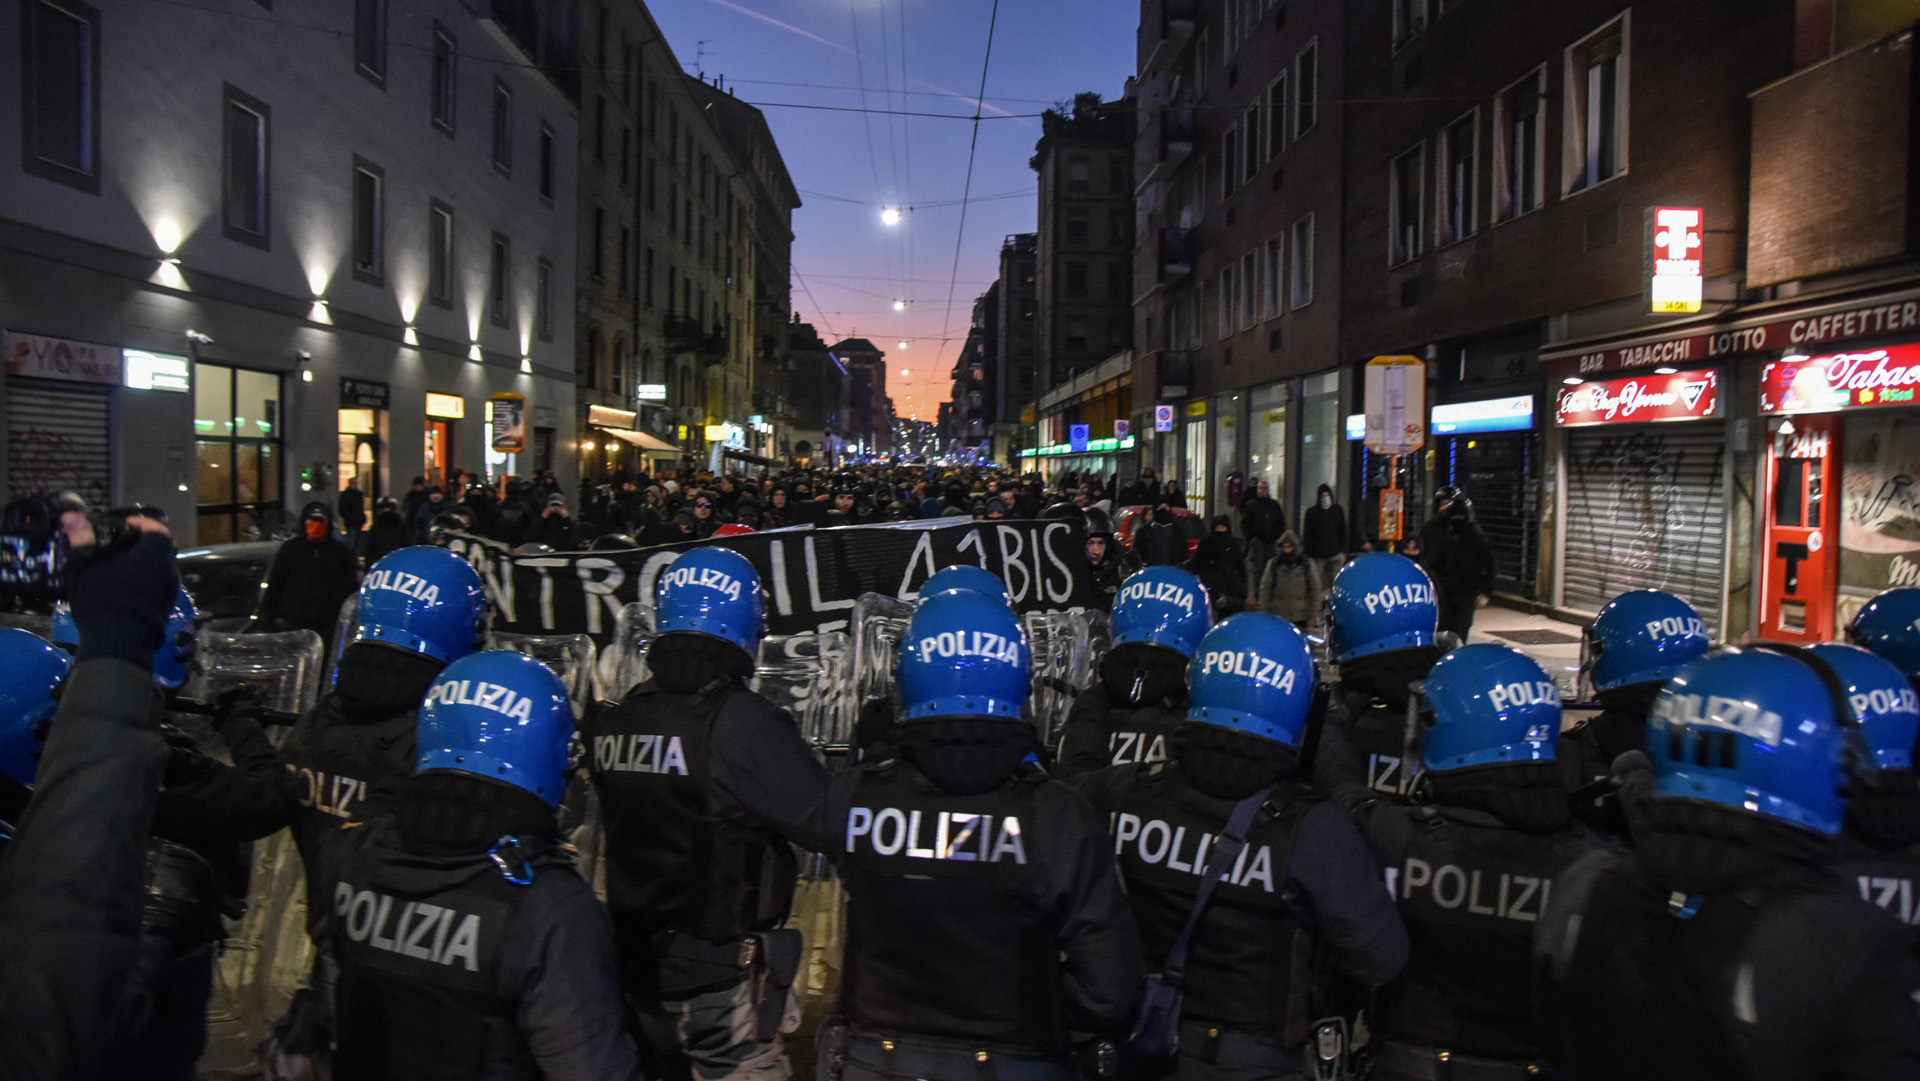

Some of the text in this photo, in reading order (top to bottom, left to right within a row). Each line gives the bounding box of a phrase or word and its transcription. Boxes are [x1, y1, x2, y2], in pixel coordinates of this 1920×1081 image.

[1579, 353, 1604, 373] BAR
[1619, 340, 1690, 368] TABACCHI
[1709, 327, 1766, 356] LOTTO
[363, 570, 440, 607] POLIZIA
[447, 538, 684, 634] ONTRO
[769, 536, 855, 617] IL
[663, 563, 741, 603] POLIZIA
[1120, 579, 1194, 613] POLIZIA
[1364, 583, 1436, 615] POLIZIA
[919, 630, 1019, 668] POLIZIA
[1645, 616, 1708, 640] POLIZ
[1203, 650, 1296, 695] POLIZIA
[425, 680, 533, 724] POLIZIA
[1487, 681, 1560, 712] POLIZ
[1848, 688, 1919, 720] POLIZ
[1652, 693, 1782, 748] POLIZIA
[594, 734, 690, 776] POLIZIA
[286, 763, 367, 819] OLIZI
[845, 806, 1027, 865] POLIZIA
[1115, 812, 1275, 893] POLIIA
[1857, 875, 1920, 926] IZI
[334, 881, 481, 972] POLIZIA
